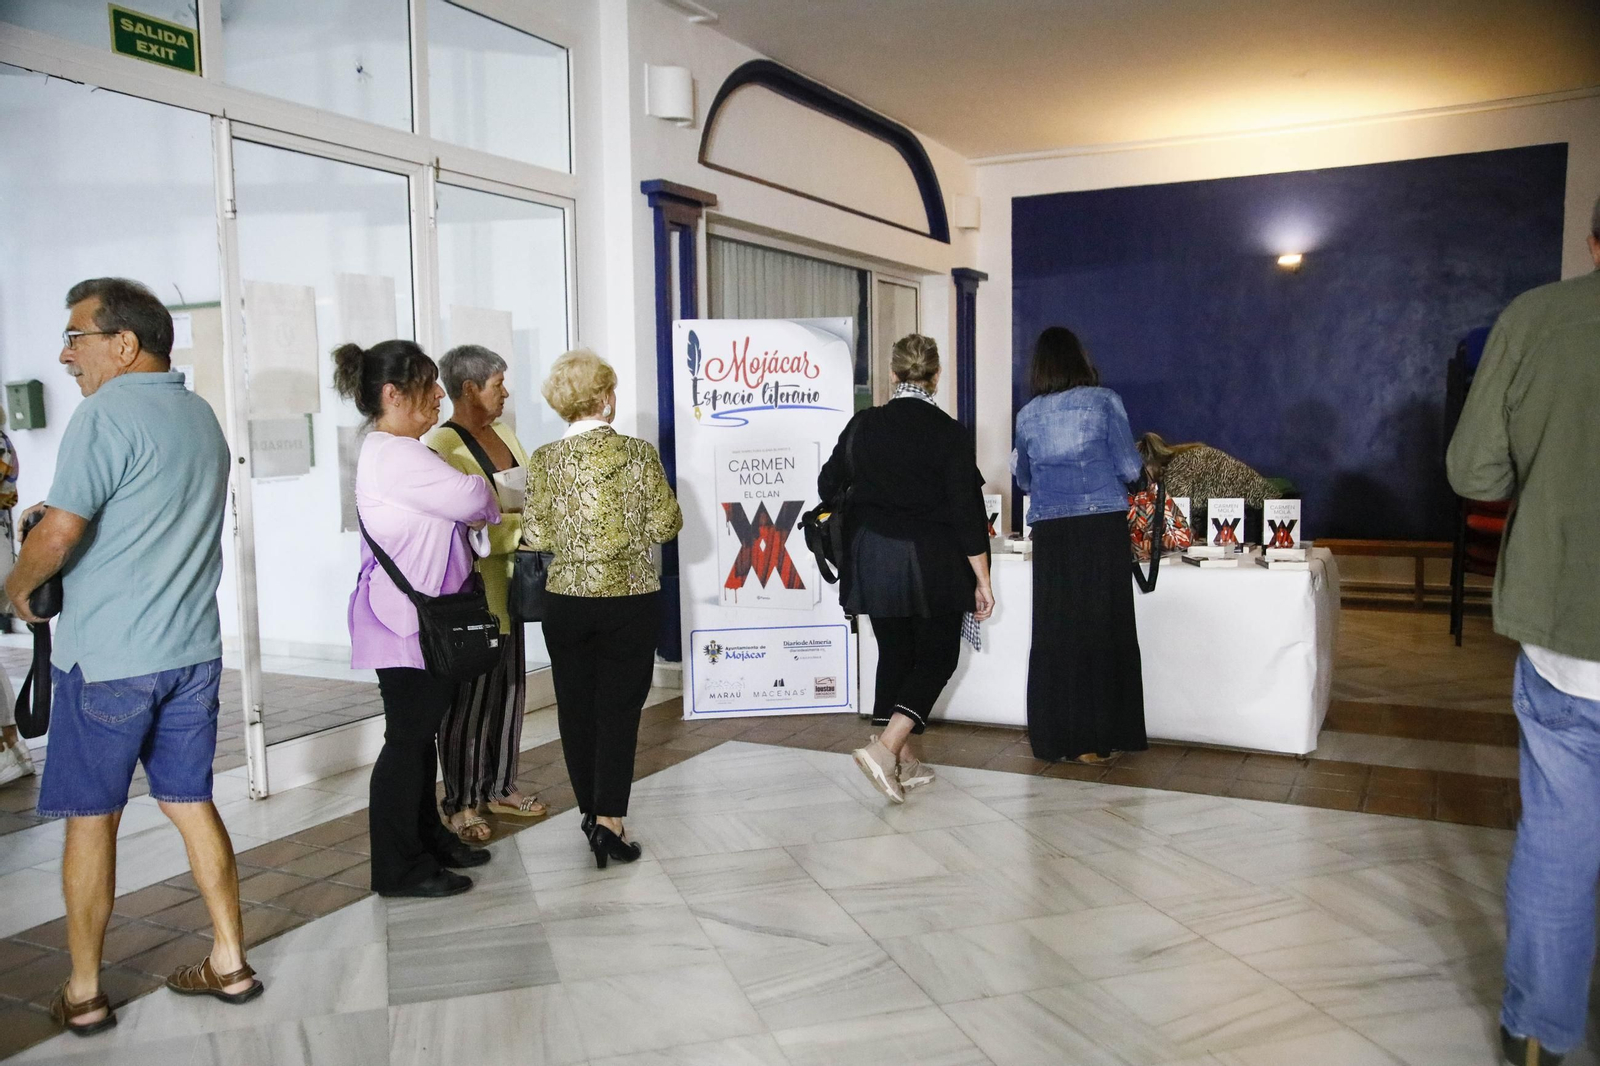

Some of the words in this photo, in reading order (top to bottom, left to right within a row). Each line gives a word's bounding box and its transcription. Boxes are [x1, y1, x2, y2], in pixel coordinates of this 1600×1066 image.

[120, 17, 189, 49] SALIDA
[136, 39, 177, 61] EXIT
[704, 336, 820, 389] Mojácar
[691, 376, 754, 411] Espacio
[762, 380, 820, 409] literario
[728, 456, 795, 473] CARMEN
[739, 472, 784, 486] MOLA
[744, 491, 754, 499] EL
[755, 490, 780, 499] CLAN
[725, 650, 766, 662] Mojácar
[753, 689, 805, 698] MACENAS
